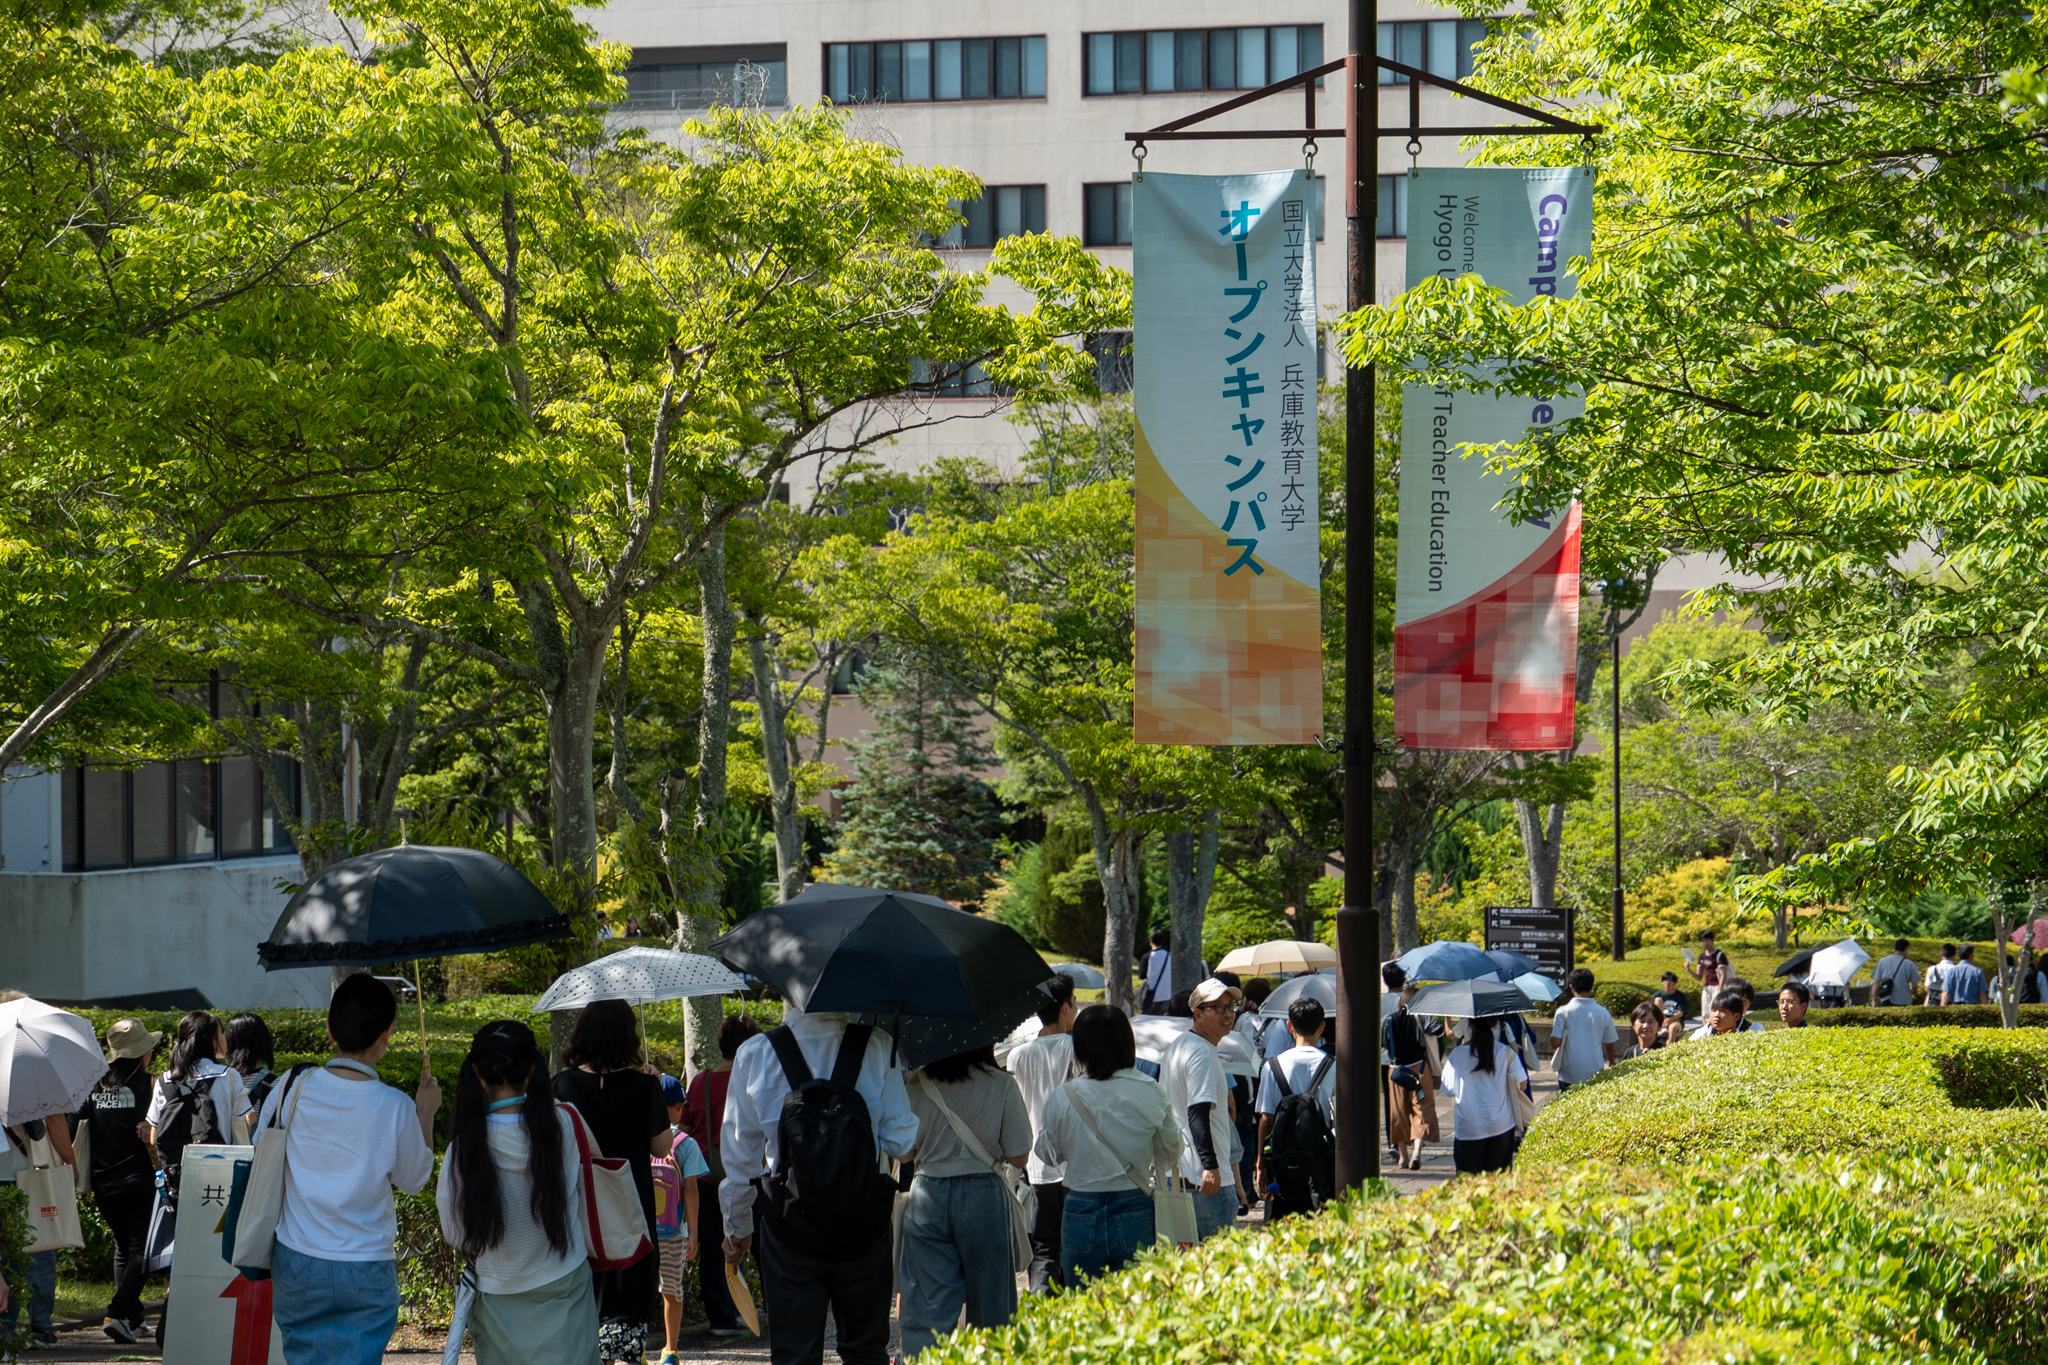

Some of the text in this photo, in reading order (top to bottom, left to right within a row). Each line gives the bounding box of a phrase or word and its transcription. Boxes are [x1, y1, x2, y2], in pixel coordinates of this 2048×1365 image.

[1433, 195, 1458, 261] Hyogo
[1462, 196, 1480, 272] Welcome
[1529, 194, 1567, 297] Camp
[1218, 200, 1268, 577] オープンキャンパス
[1280, 200, 1306, 531] 国立大学法人 兵庫教育大学
[1431, 402, 1453, 485] Teacher
[1428, 490, 1450, 592] Education
[96, 1100, 118, 1109] FACE
